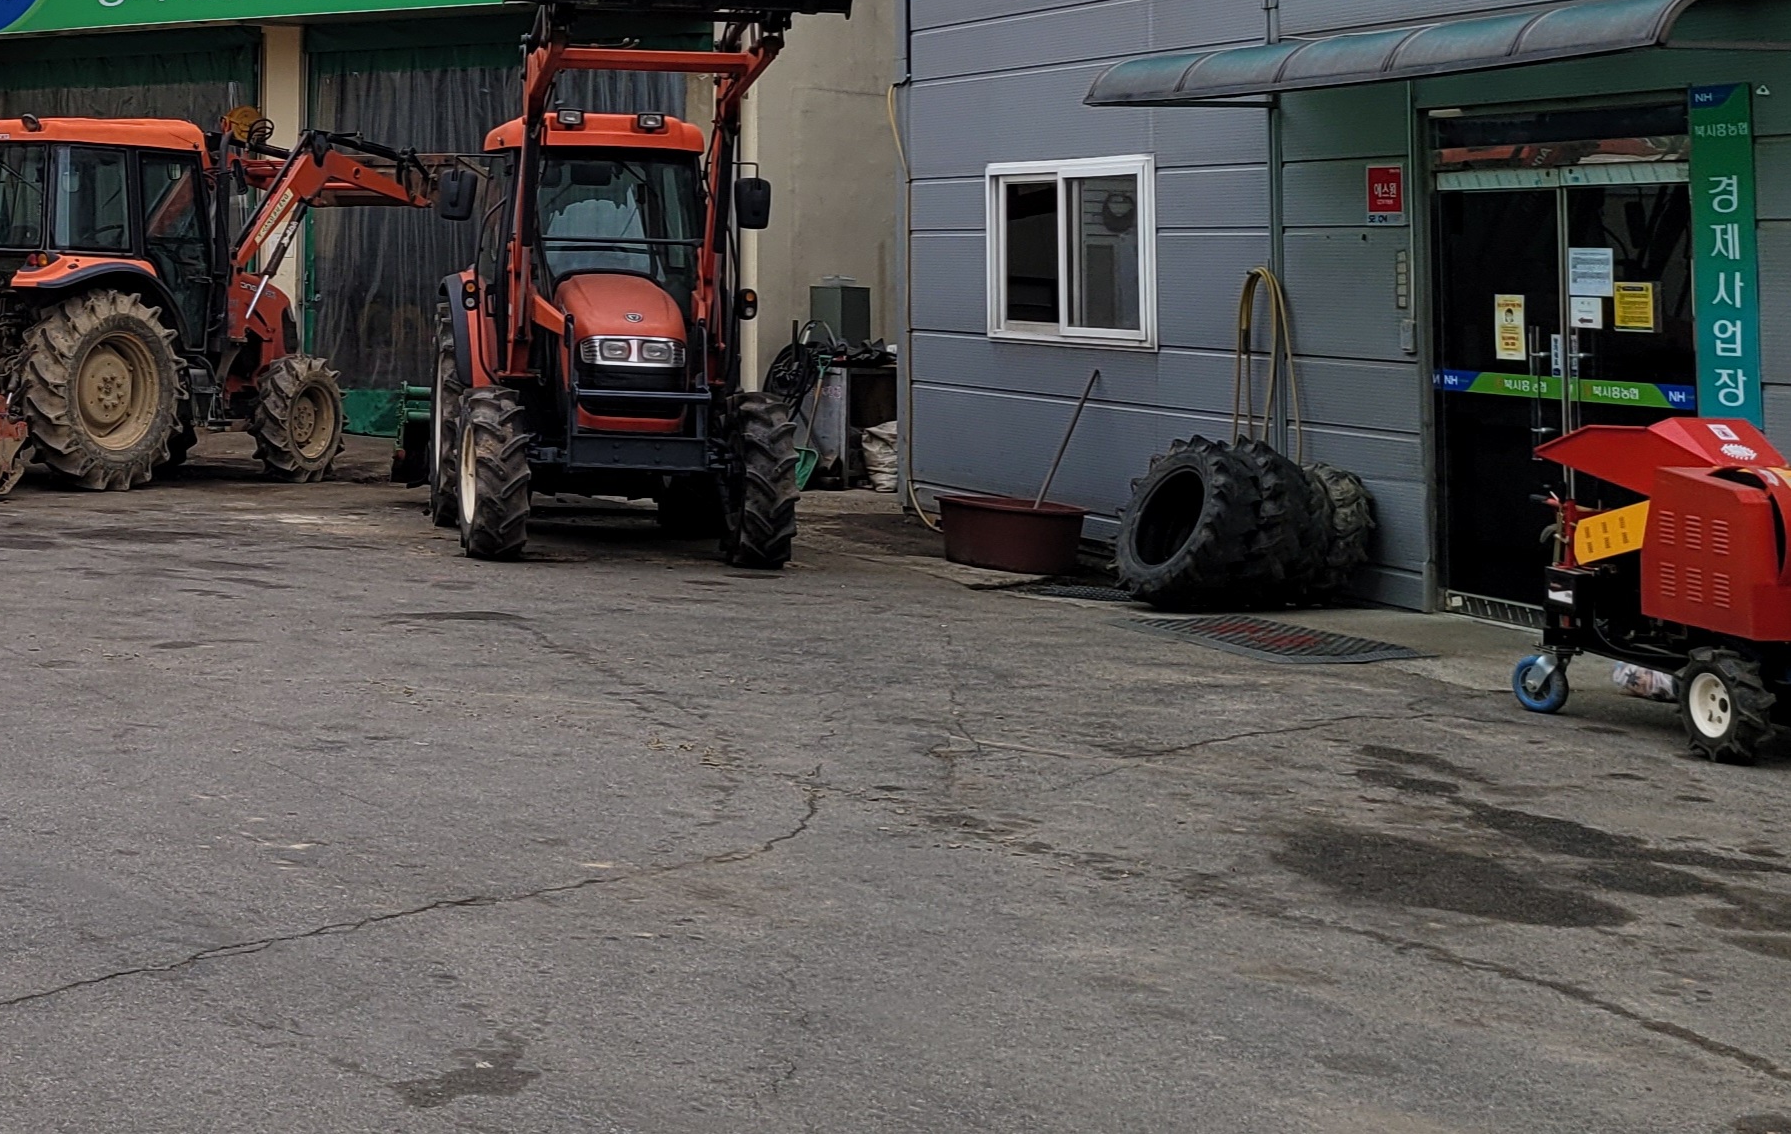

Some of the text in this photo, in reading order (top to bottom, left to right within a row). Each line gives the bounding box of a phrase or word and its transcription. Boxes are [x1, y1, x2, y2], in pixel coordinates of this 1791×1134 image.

[1694, 92, 1713, 103] NH
[1694, 122, 1748, 137] 북시흥농협
[1373, 182, 1397, 198] 에스원
[1707, 174, 1750, 408] 경제사업장
[1444, 375, 1458, 385] NH
[1592, 385, 1640, 400] 북시흥농협
[1668, 390, 1686, 403] NH
